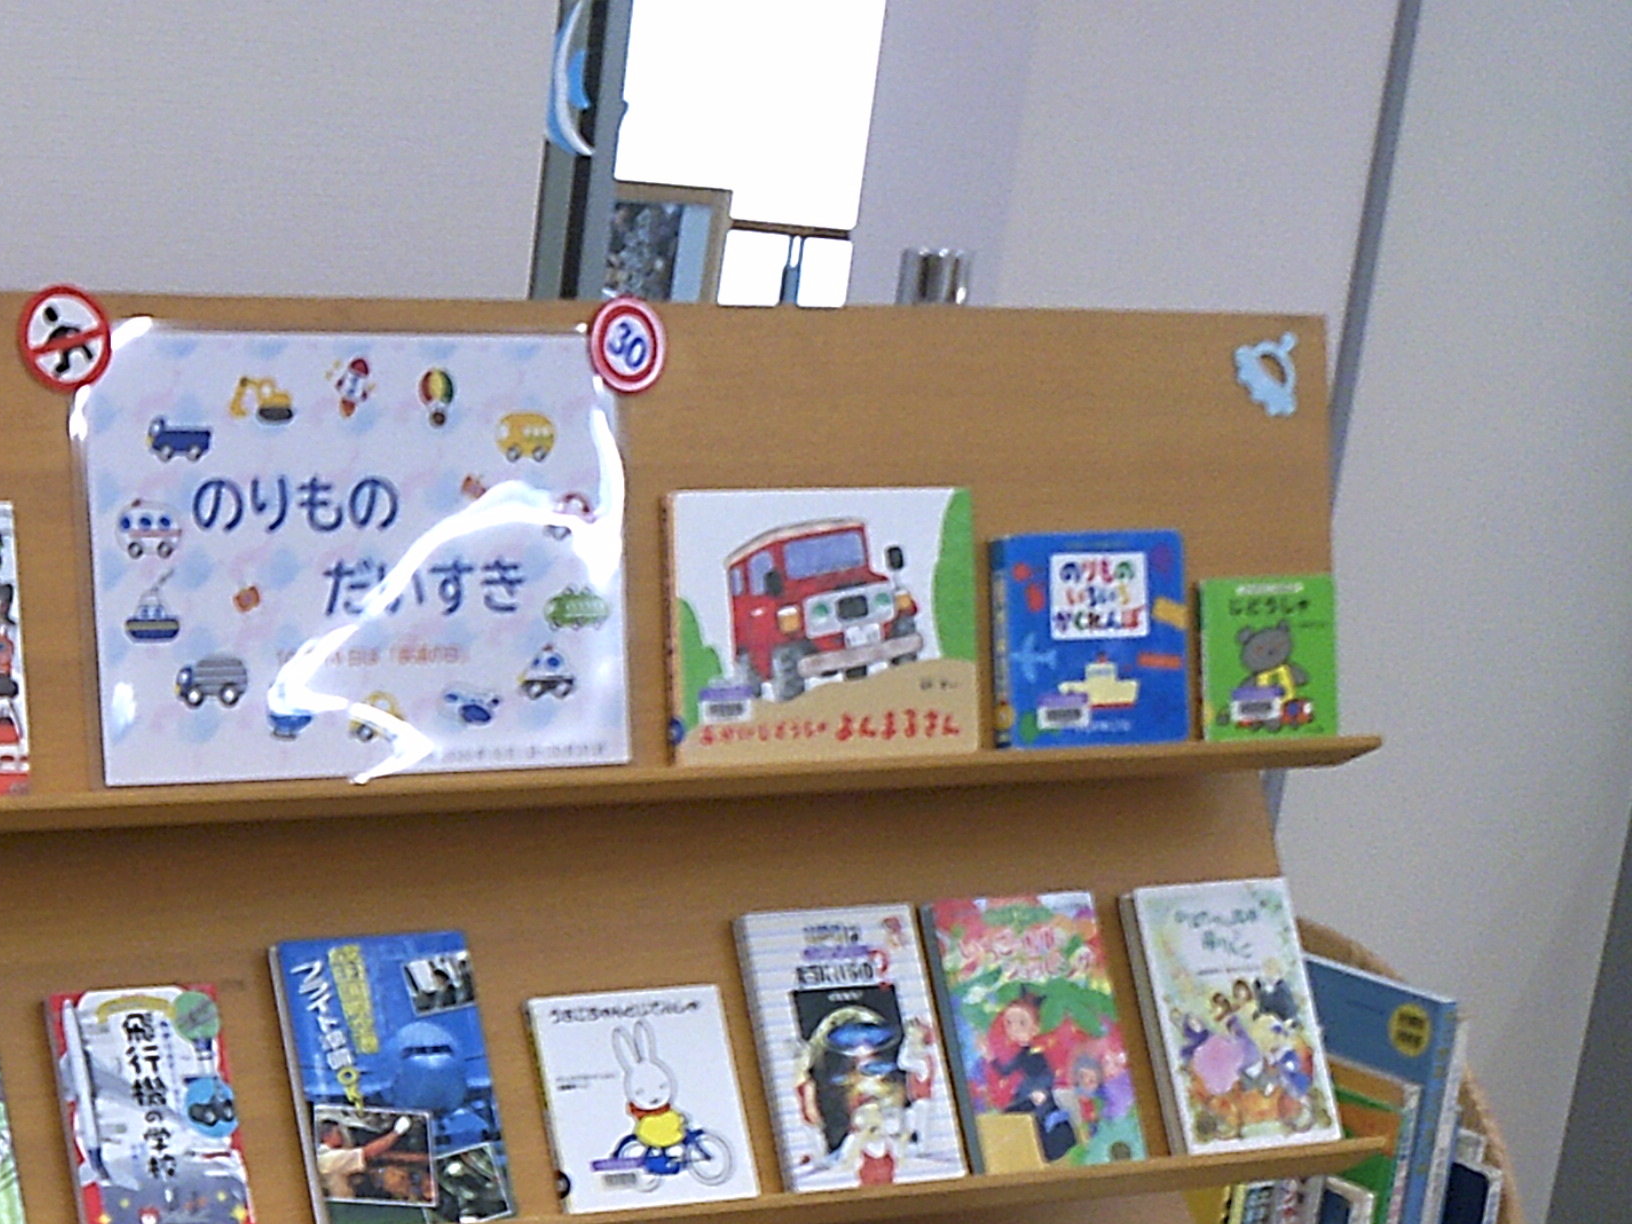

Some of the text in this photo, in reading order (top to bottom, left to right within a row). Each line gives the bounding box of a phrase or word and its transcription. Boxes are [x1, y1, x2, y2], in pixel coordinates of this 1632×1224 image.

[606, 320, 648, 371] 30
[192, 475, 399, 534] のりもの
[323, 556, 526, 619] だいすき
